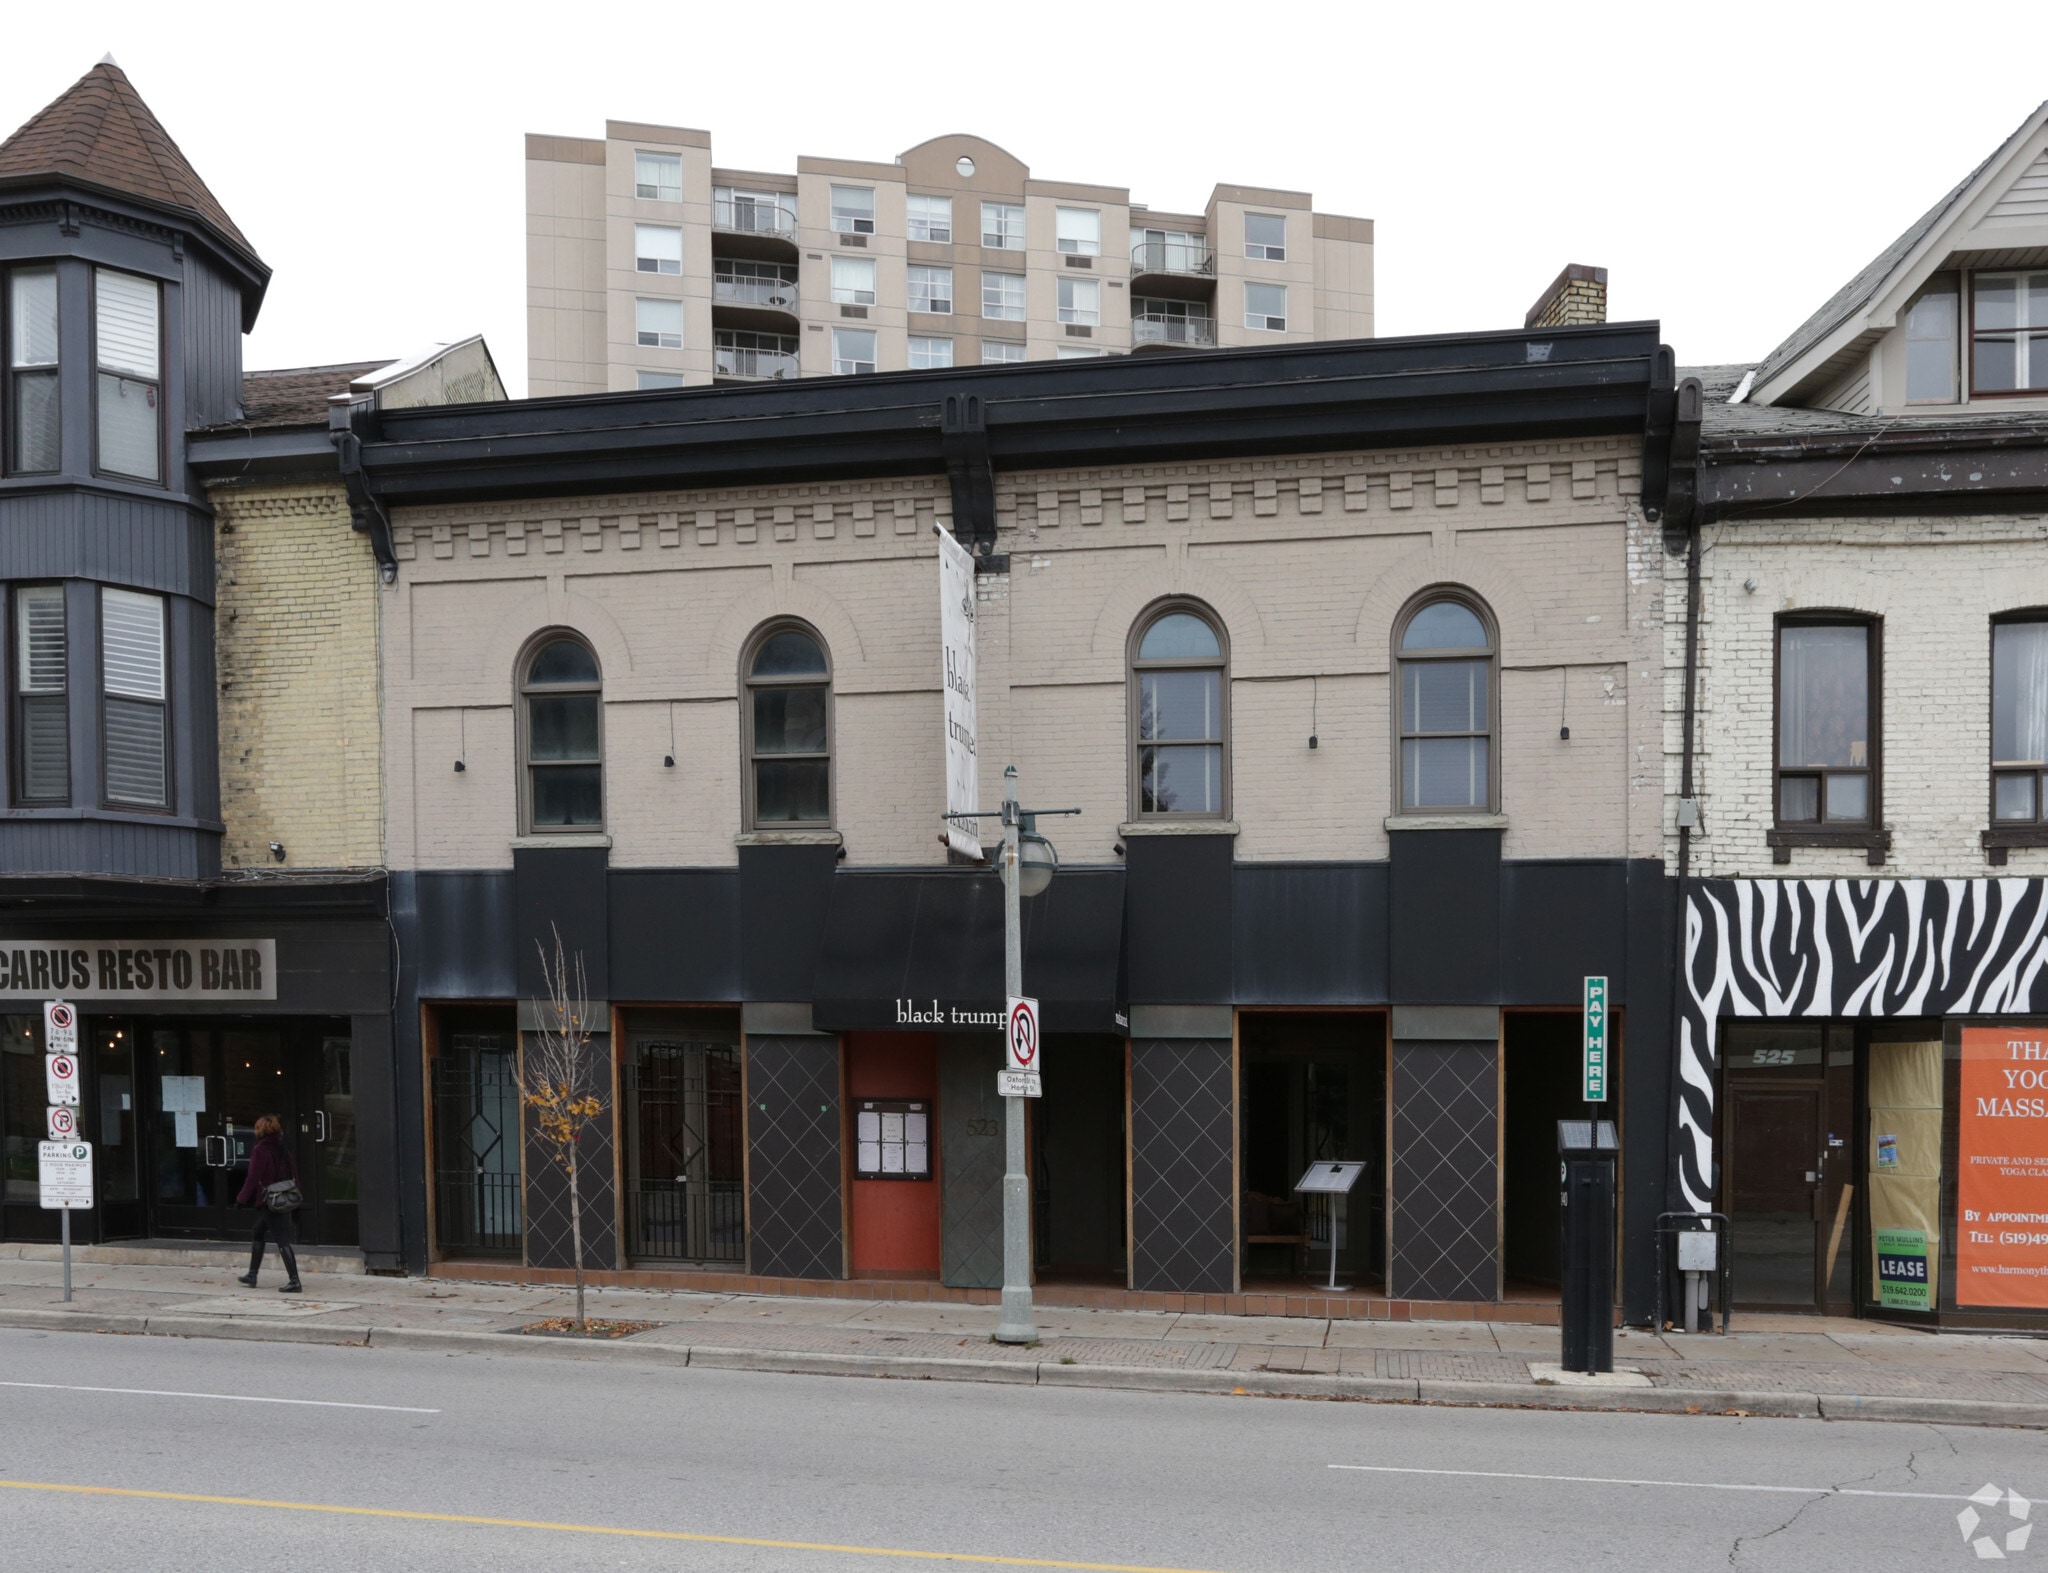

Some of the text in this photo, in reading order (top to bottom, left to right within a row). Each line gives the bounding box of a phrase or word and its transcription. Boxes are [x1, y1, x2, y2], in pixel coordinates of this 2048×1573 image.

[98, 949, 192, 990] RESTO
[201, 948, 262, 990] BAR
[895, 999, 945, 1024] black
[1588, 986, 1603, 1092] PAY HERE
[1752, 1048, 1796, 1065] 525
[1976, 1097, 2048, 1118] MASS
[966, 1118, 999, 1137] 523
[1970, 1156, 2048, 1167] PRIVATE AND SE
[2000, 1168, 2026, 1177] YOGA
[1881, 1259, 1925, 1277] LEASE
